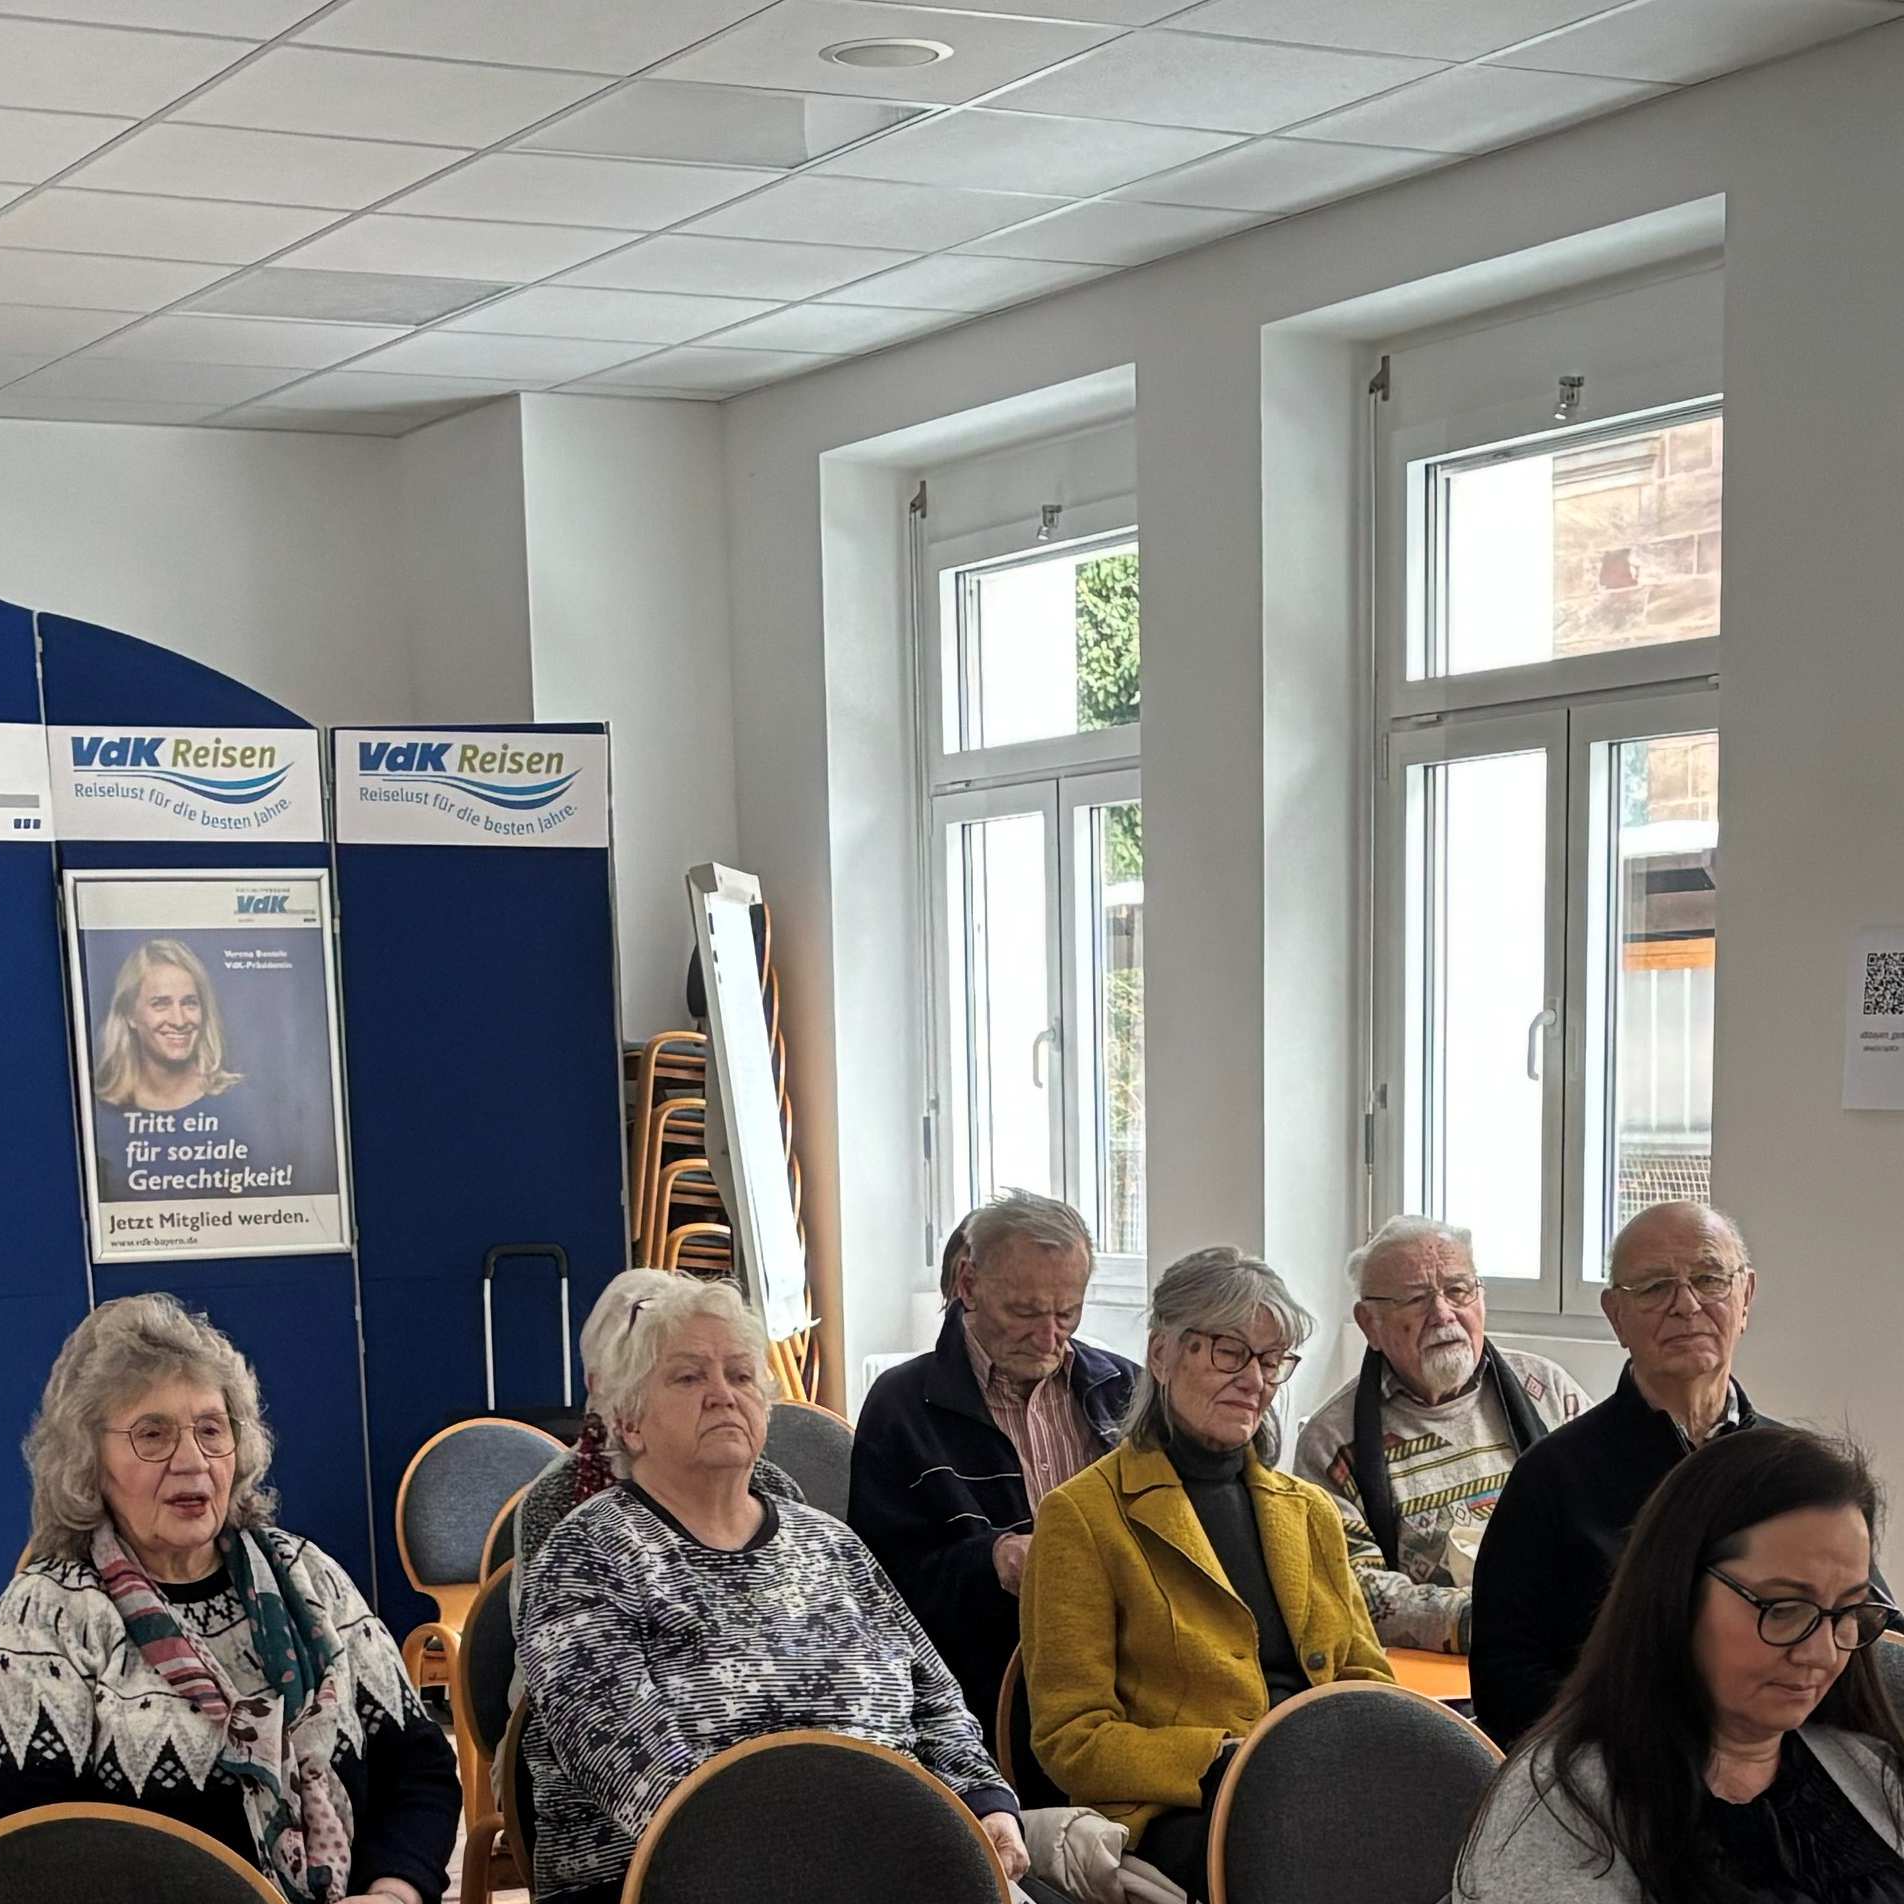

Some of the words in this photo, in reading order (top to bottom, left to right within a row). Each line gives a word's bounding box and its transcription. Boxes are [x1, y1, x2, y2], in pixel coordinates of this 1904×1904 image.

[70, 736, 166, 767] VdK
[171, 737, 276, 769] Reisen
[358, 741, 454, 773] VdK
[457, 743, 564, 775] Reisen
[74, 782, 144, 801] Reiselust
[149, 787, 172, 809] für
[173, 800, 197, 821] die
[200, 809, 252, 830] besten
[254, 797, 292, 828] Jahre.
[359, 786, 429, 806] Reiselust
[432, 793, 456, 814] für
[457, 805, 480, 826] die
[484, 815, 535, 836] besten
[539, 804, 578, 834] Jahre.
[236, 895, 290, 914] VdK
[124, 1112, 176, 1134] Tritt
[183, 1112, 219, 1132] ein
[126, 1141, 161, 1168] für
[167, 1139, 248, 1161] soziale
[128, 1165, 293, 1193] Gerechtigkeit!
[109, 1215, 154, 1234] Jetzt
[159, 1211, 233, 1232] Mitglied
[238, 1209, 310, 1226] werden.
